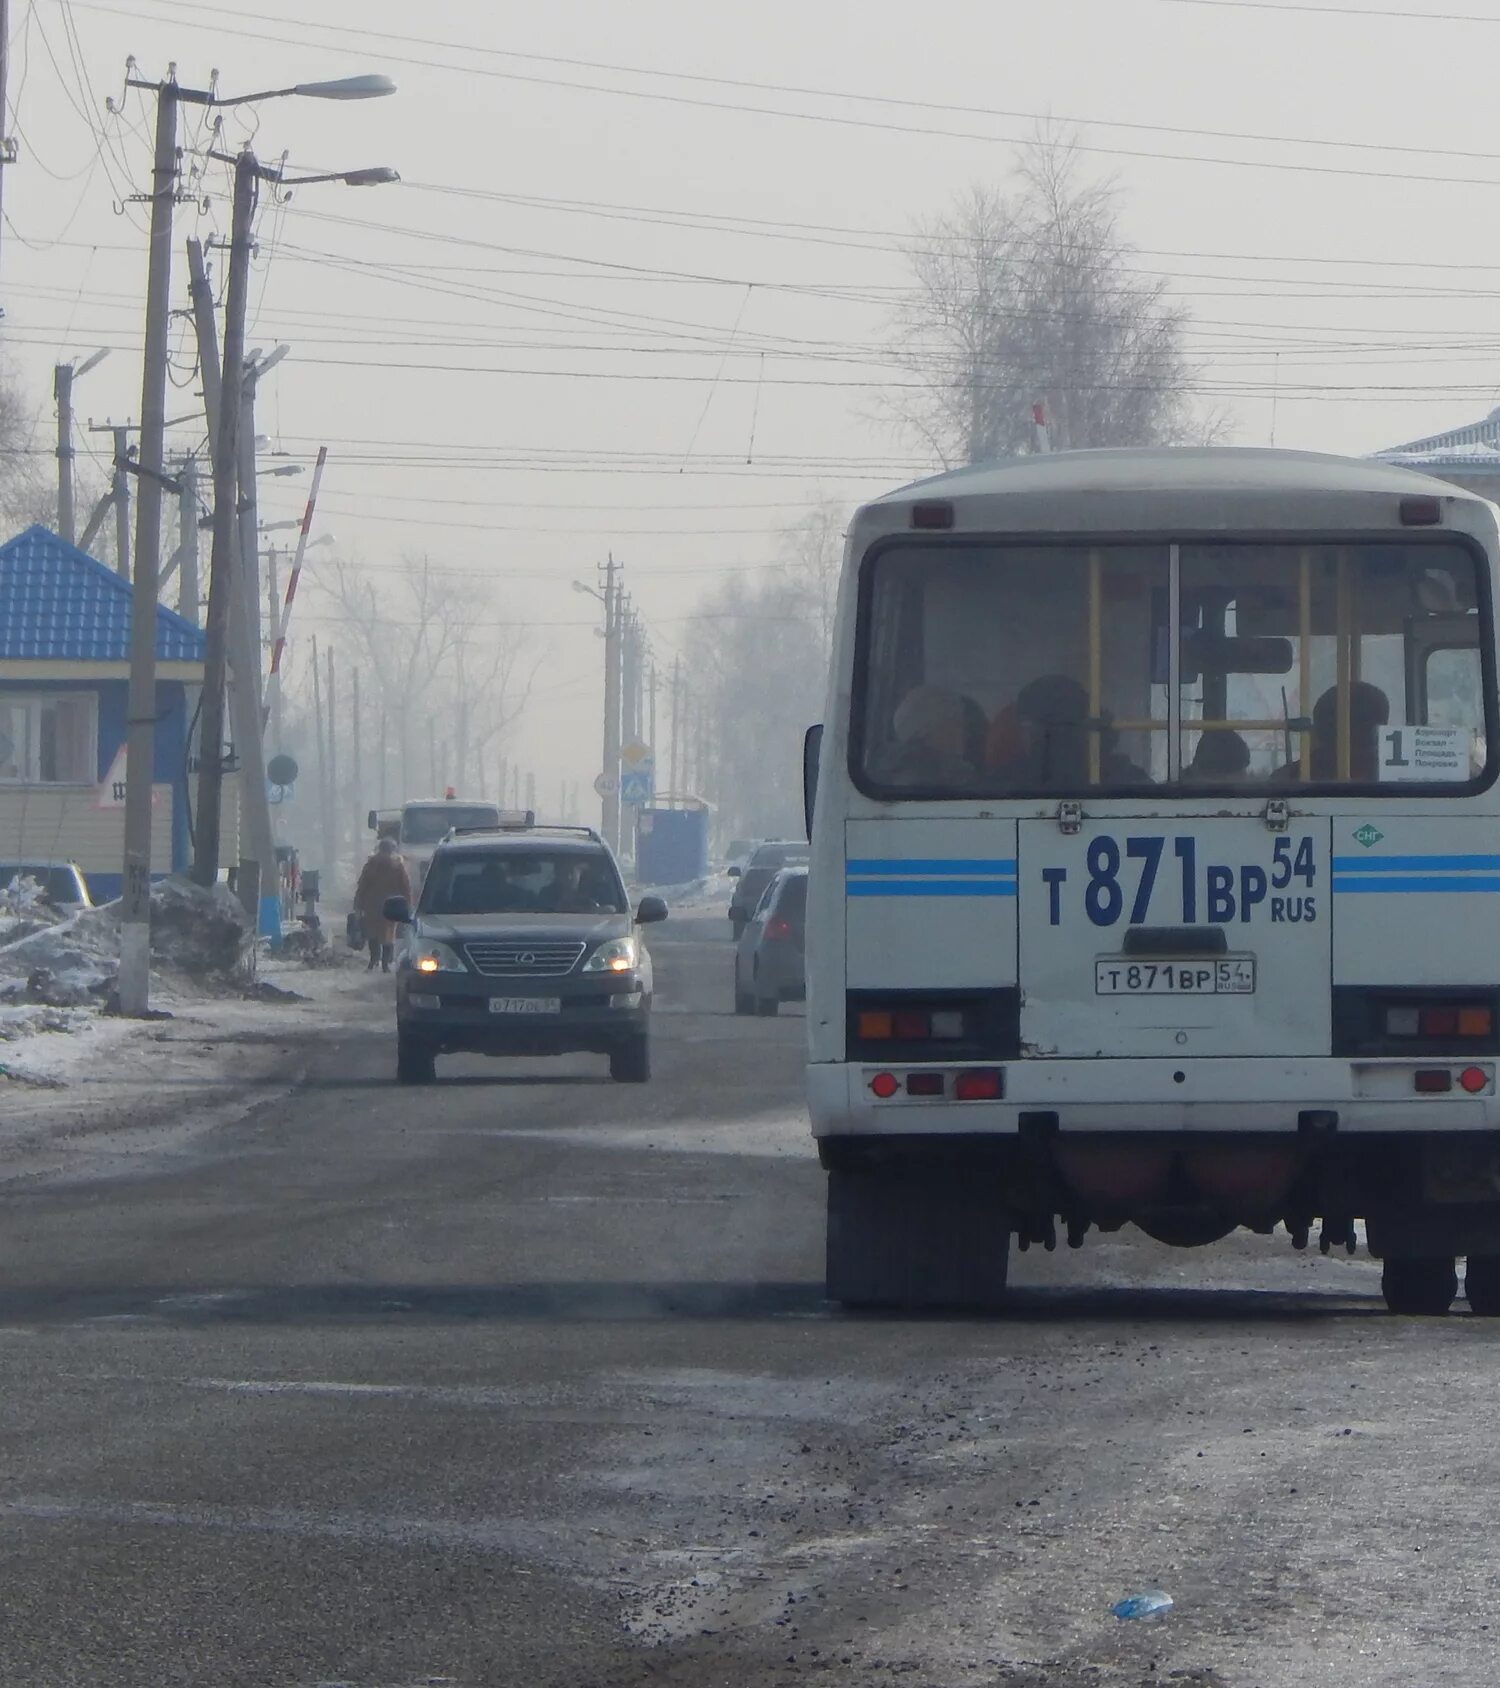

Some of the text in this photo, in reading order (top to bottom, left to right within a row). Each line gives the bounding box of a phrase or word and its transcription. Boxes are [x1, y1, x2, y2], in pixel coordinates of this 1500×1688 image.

[1385, 730, 1409, 766] 1
[1271, 837, 1316, 889] 54
[1271, 897, 1316, 922] RUS
[1219, 963, 1245, 982] 54
